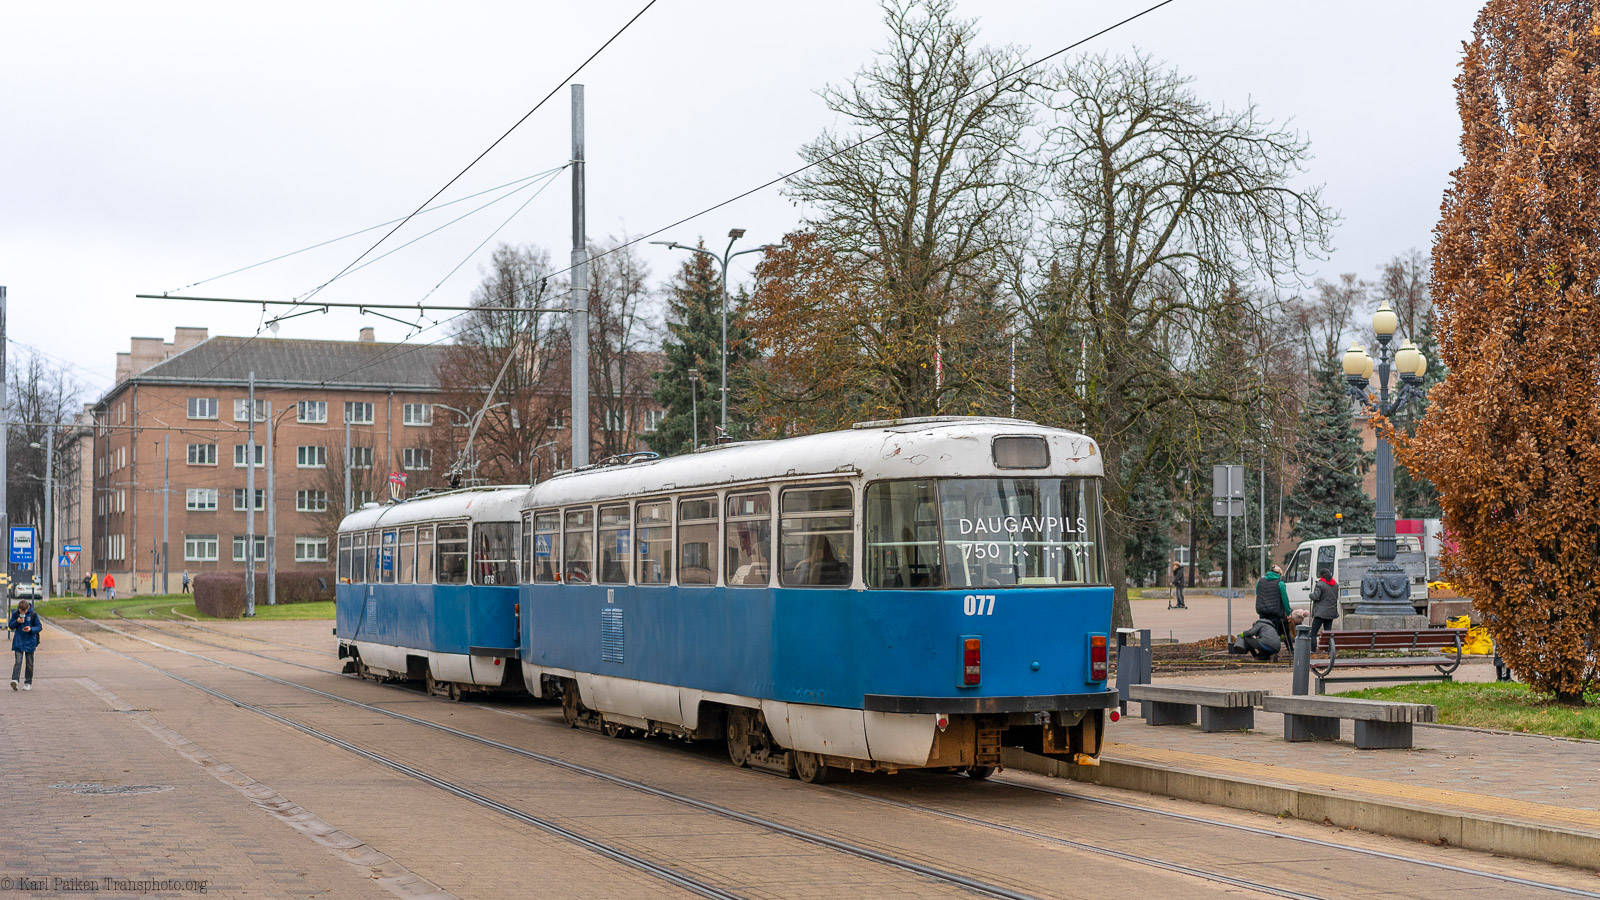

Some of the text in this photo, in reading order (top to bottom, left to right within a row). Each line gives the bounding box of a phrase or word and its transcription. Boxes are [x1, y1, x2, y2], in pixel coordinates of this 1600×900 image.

[960, 516, 1087, 534] DAUGAVPILS
[962, 542, 1000, 559] 750
[484, 575, 495, 585] 078
[963, 595, 996, 616] 077
